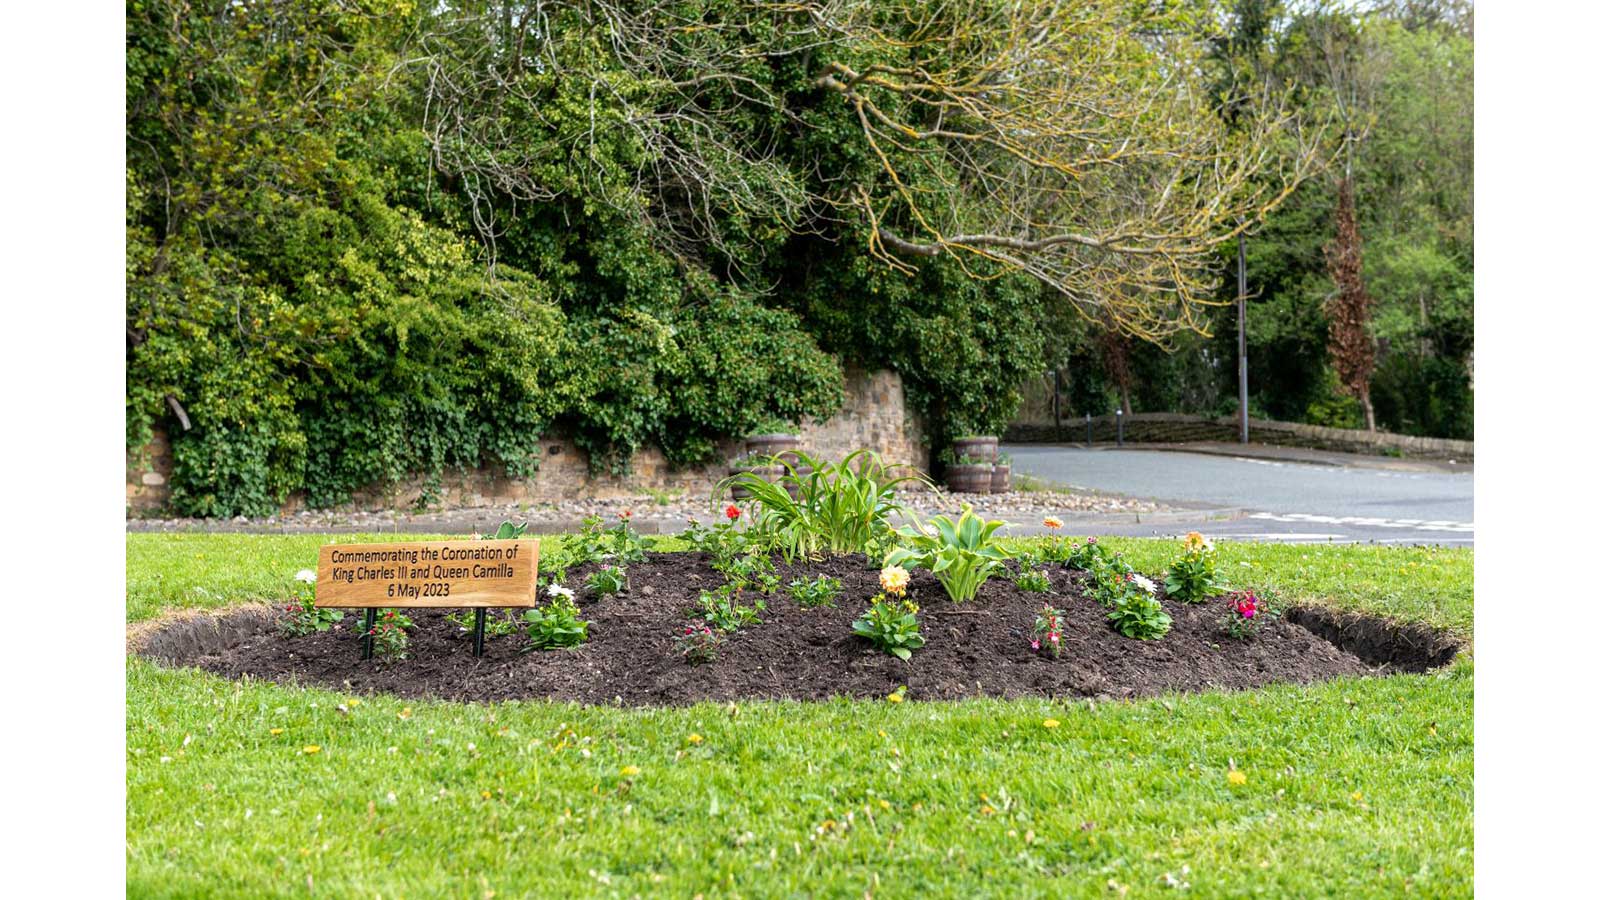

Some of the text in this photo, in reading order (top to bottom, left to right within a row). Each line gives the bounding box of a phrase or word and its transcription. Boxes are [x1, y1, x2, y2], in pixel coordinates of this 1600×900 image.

[331, 544, 518, 564] Commemorating the Coronation of
[333, 563, 513, 583] King Charles III and Queen Camilla
[387, 583, 450, 600] 6 May 2023
